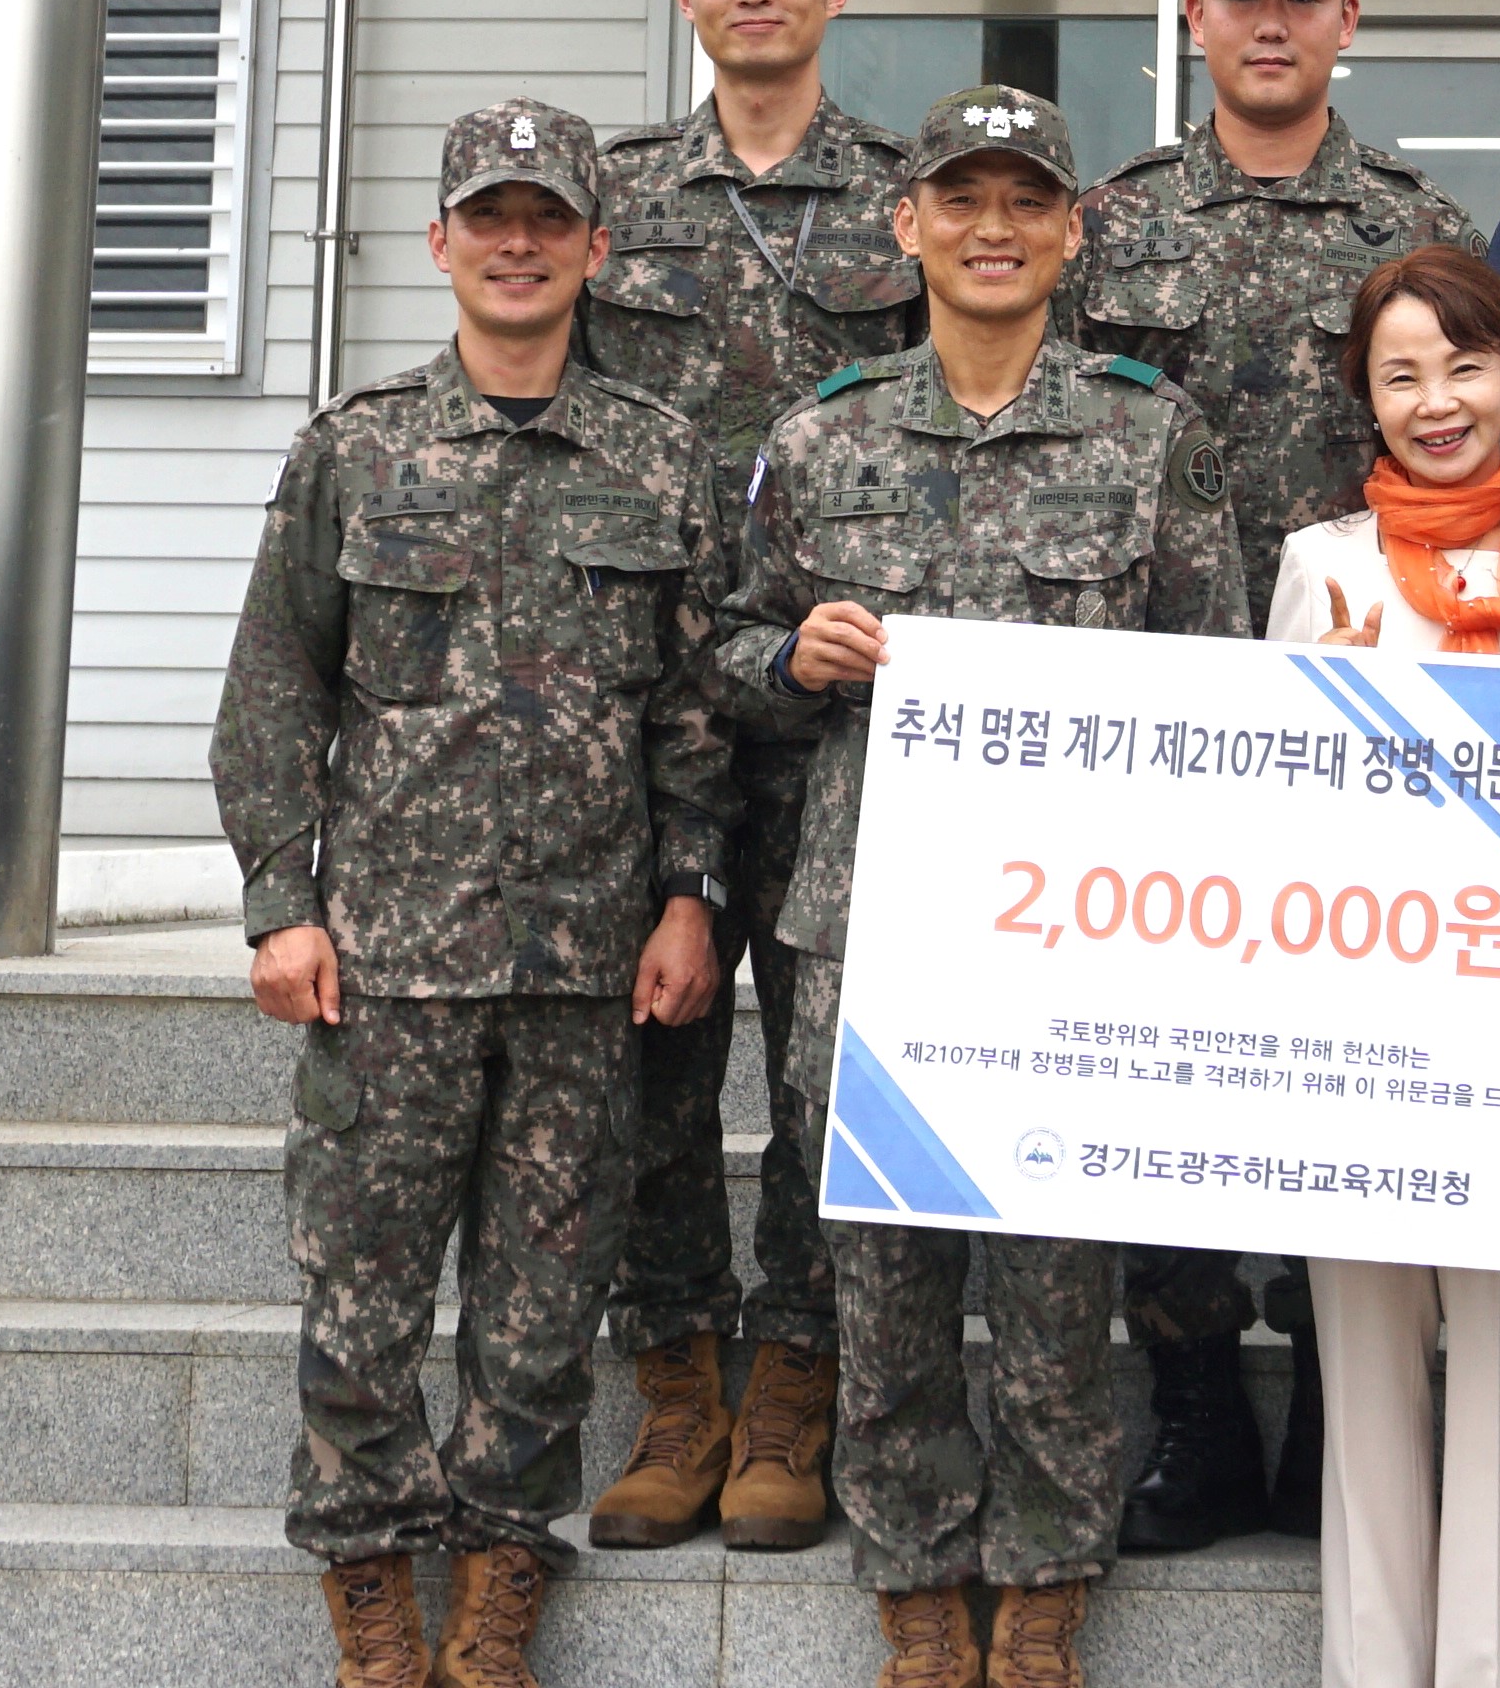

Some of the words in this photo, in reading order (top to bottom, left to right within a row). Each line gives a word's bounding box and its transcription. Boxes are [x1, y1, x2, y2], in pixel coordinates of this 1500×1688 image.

[565, 494, 609, 507] 대한민국
[612, 495, 632, 508] 육군
[1033, 492, 1079, 506] 대한민국
[1083, 491, 1105, 505] 육군
[1108, 491, 1133, 507] ROKA
[891, 698, 964, 761] 추석
[980, 707, 1051, 768] 명절
[1063, 714, 1137, 775] 계기
[1150, 720, 1348, 791] 제2107부대
[1362, 735, 1435, 797] 장병
[1048, 1018, 1161, 1049] 국토방위와
[1168, 1027, 1281, 1059] 국민안전을
[1289, 1036, 1333, 1062] 위해
[1342, 1040, 1432, 1070] 헌신하는
[901, 1041, 1021, 1072] 제2107부대
[1029, 1050, 1119, 1080] 장병들의
[1127, 1059, 1196, 1086] 노고를
[1203, 1063, 1293, 1094] 격려하기
[1301, 1071, 1346, 1097] 위해
[1355, 1076, 1376, 1100] 이
[1384, 1078, 1476, 1108] 위문금을
[1078, 1143, 1472, 1206] 경기도광주하남교육지원청
